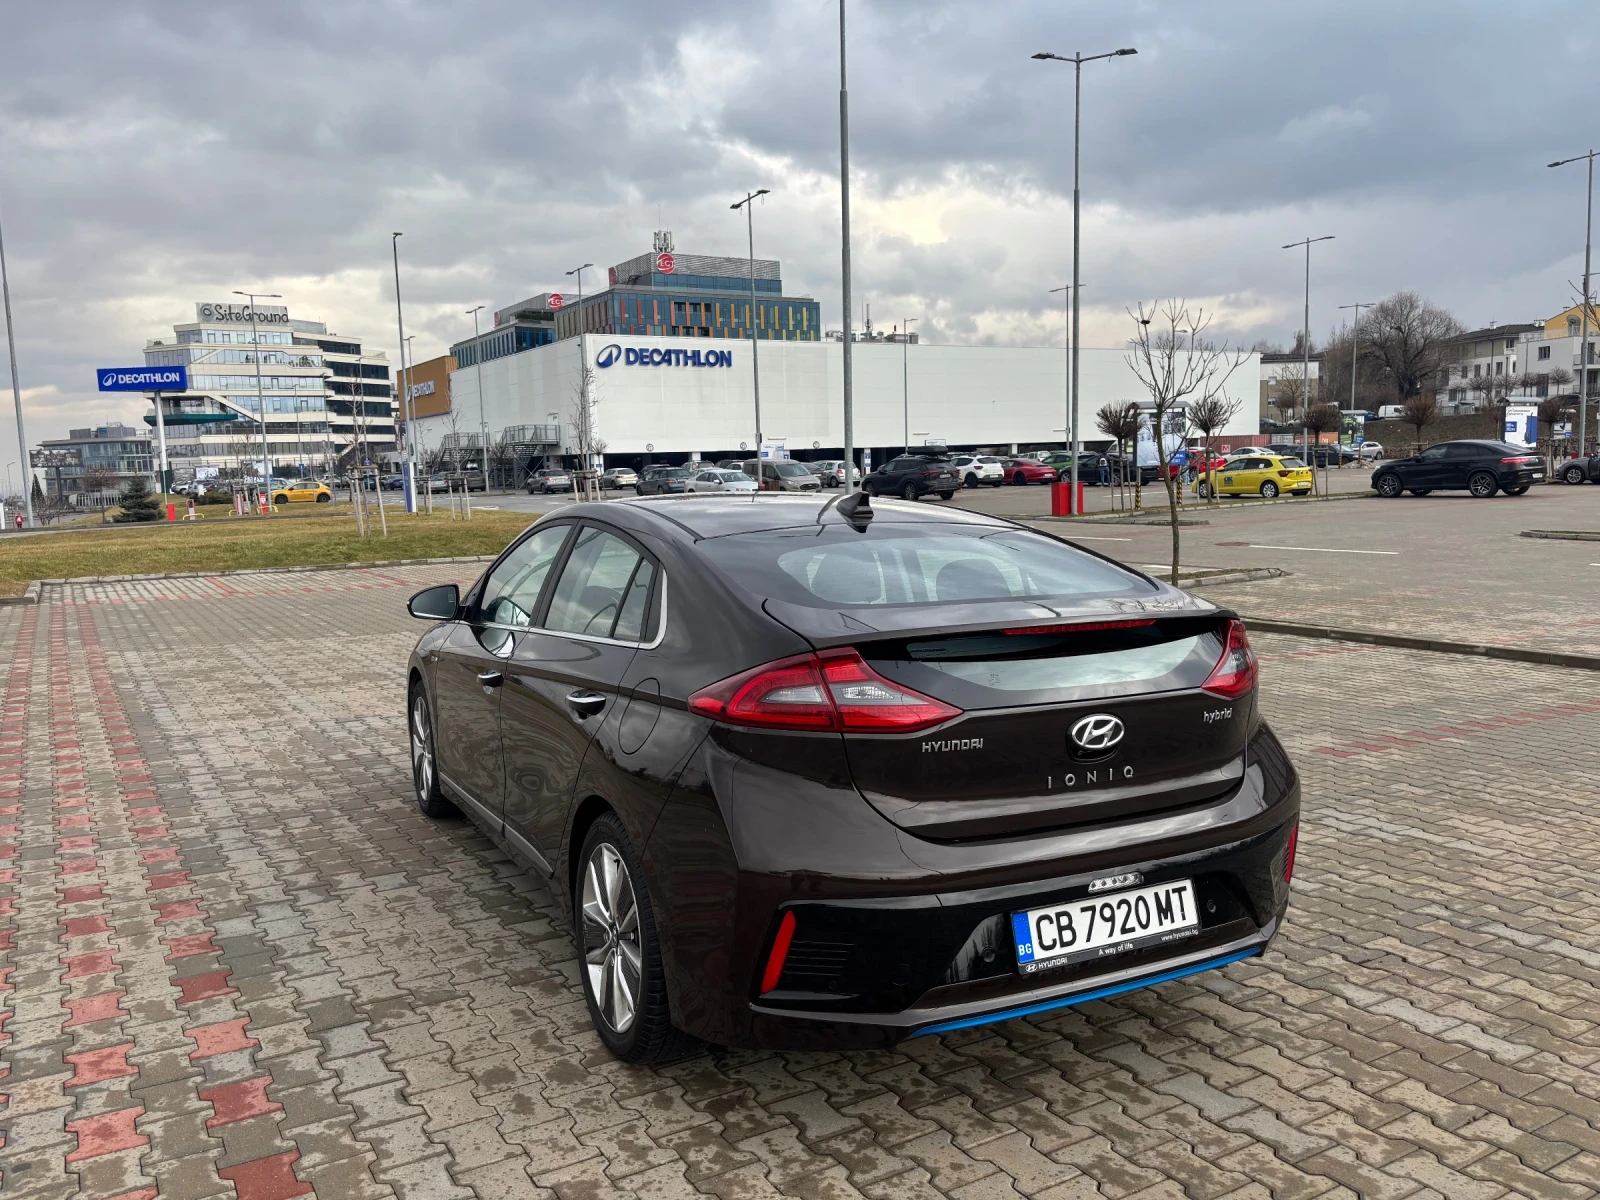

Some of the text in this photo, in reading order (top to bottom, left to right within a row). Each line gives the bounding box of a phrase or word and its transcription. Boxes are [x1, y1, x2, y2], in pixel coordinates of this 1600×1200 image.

[214, 304, 290, 323] SiteGround
[625, 347, 733, 368] DECATHLON
[118, 372, 181, 384] DECATHLON
[1203, 707, 1233, 724] hybrid
[921, 738, 984, 753] HYUNDAI
[1047, 766, 1134, 789] IONIQ
[1036, 885, 1188, 952] CB 7920 MT
[1018, 943, 1033, 956] BG
[1098, 948, 1104, 956] A
[1104, 946, 1116, 955] way
[1117, 944, 1124, 952] of
[1038, 957, 1068, 970] HYUNDAI
